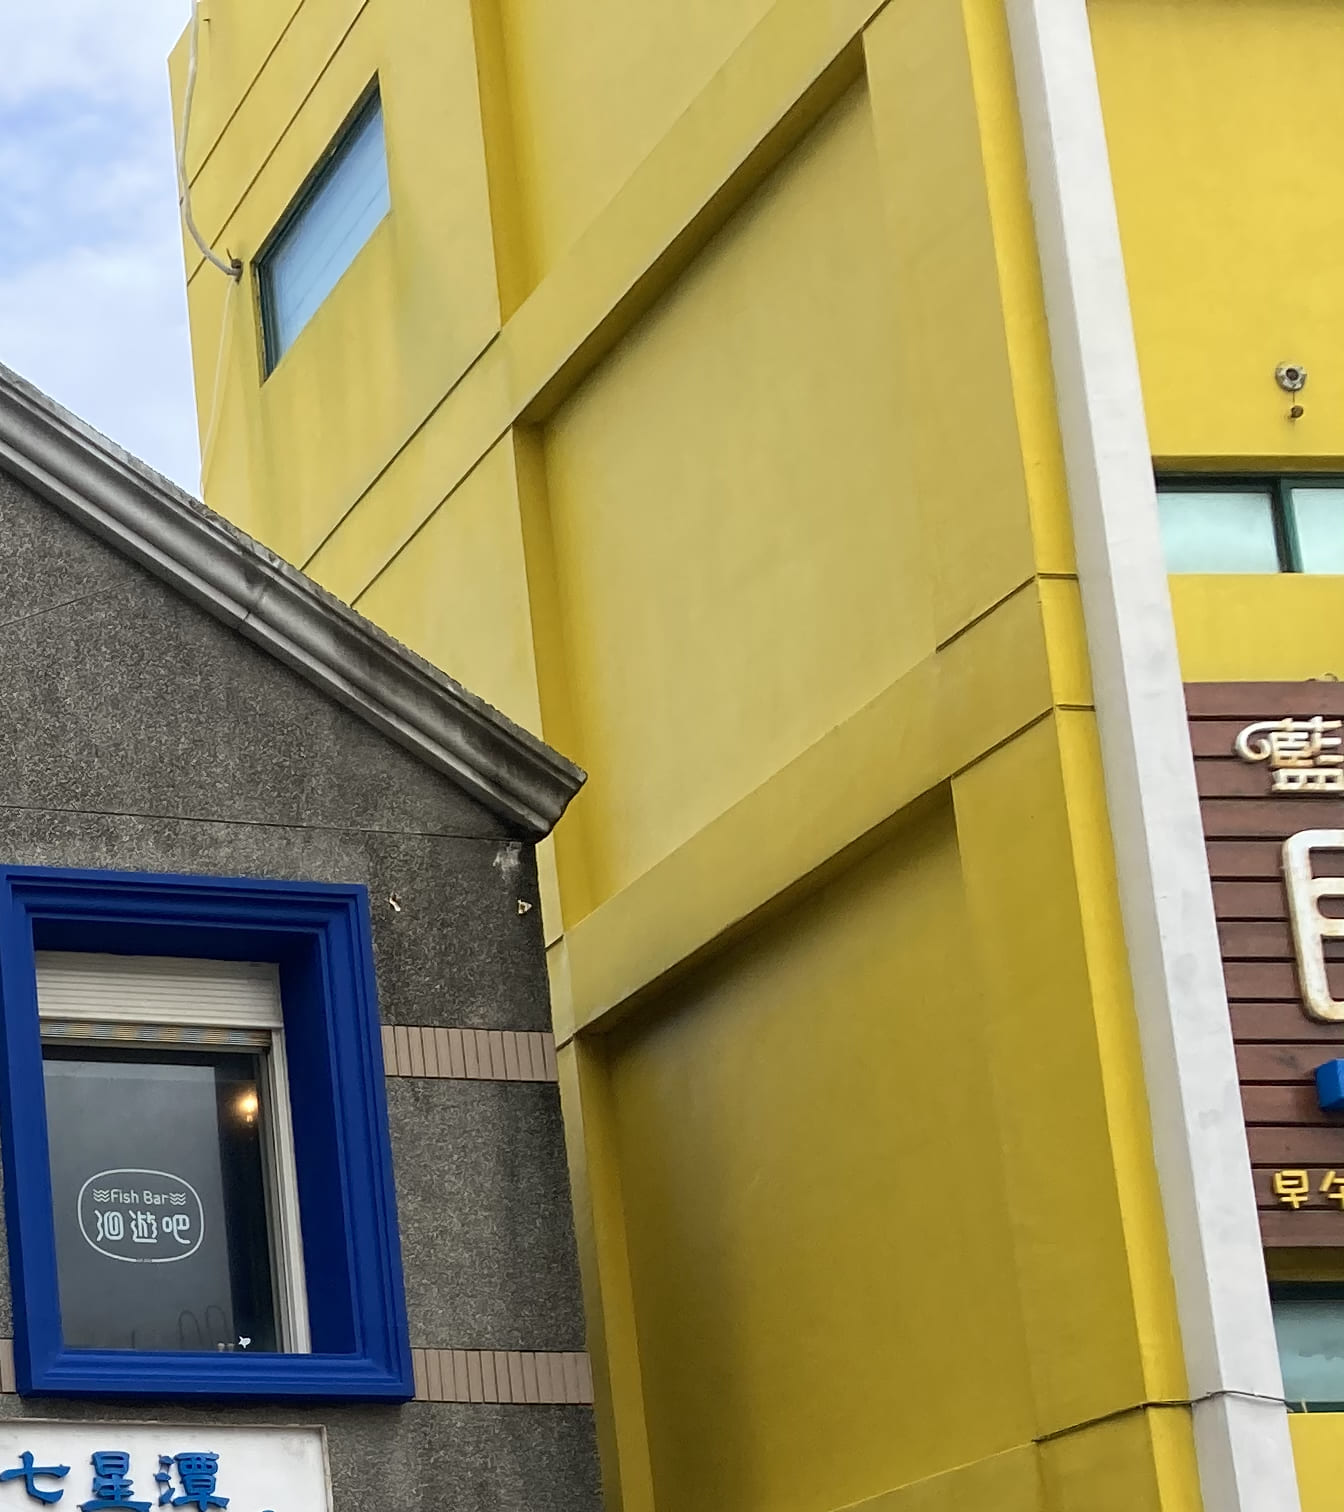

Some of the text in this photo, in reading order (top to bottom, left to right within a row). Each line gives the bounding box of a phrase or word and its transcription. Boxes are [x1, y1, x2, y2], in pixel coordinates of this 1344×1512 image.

[110, 1189, 170, 1205] Fish Bar
[94, 1210, 192, 1244] 洄遊吧
